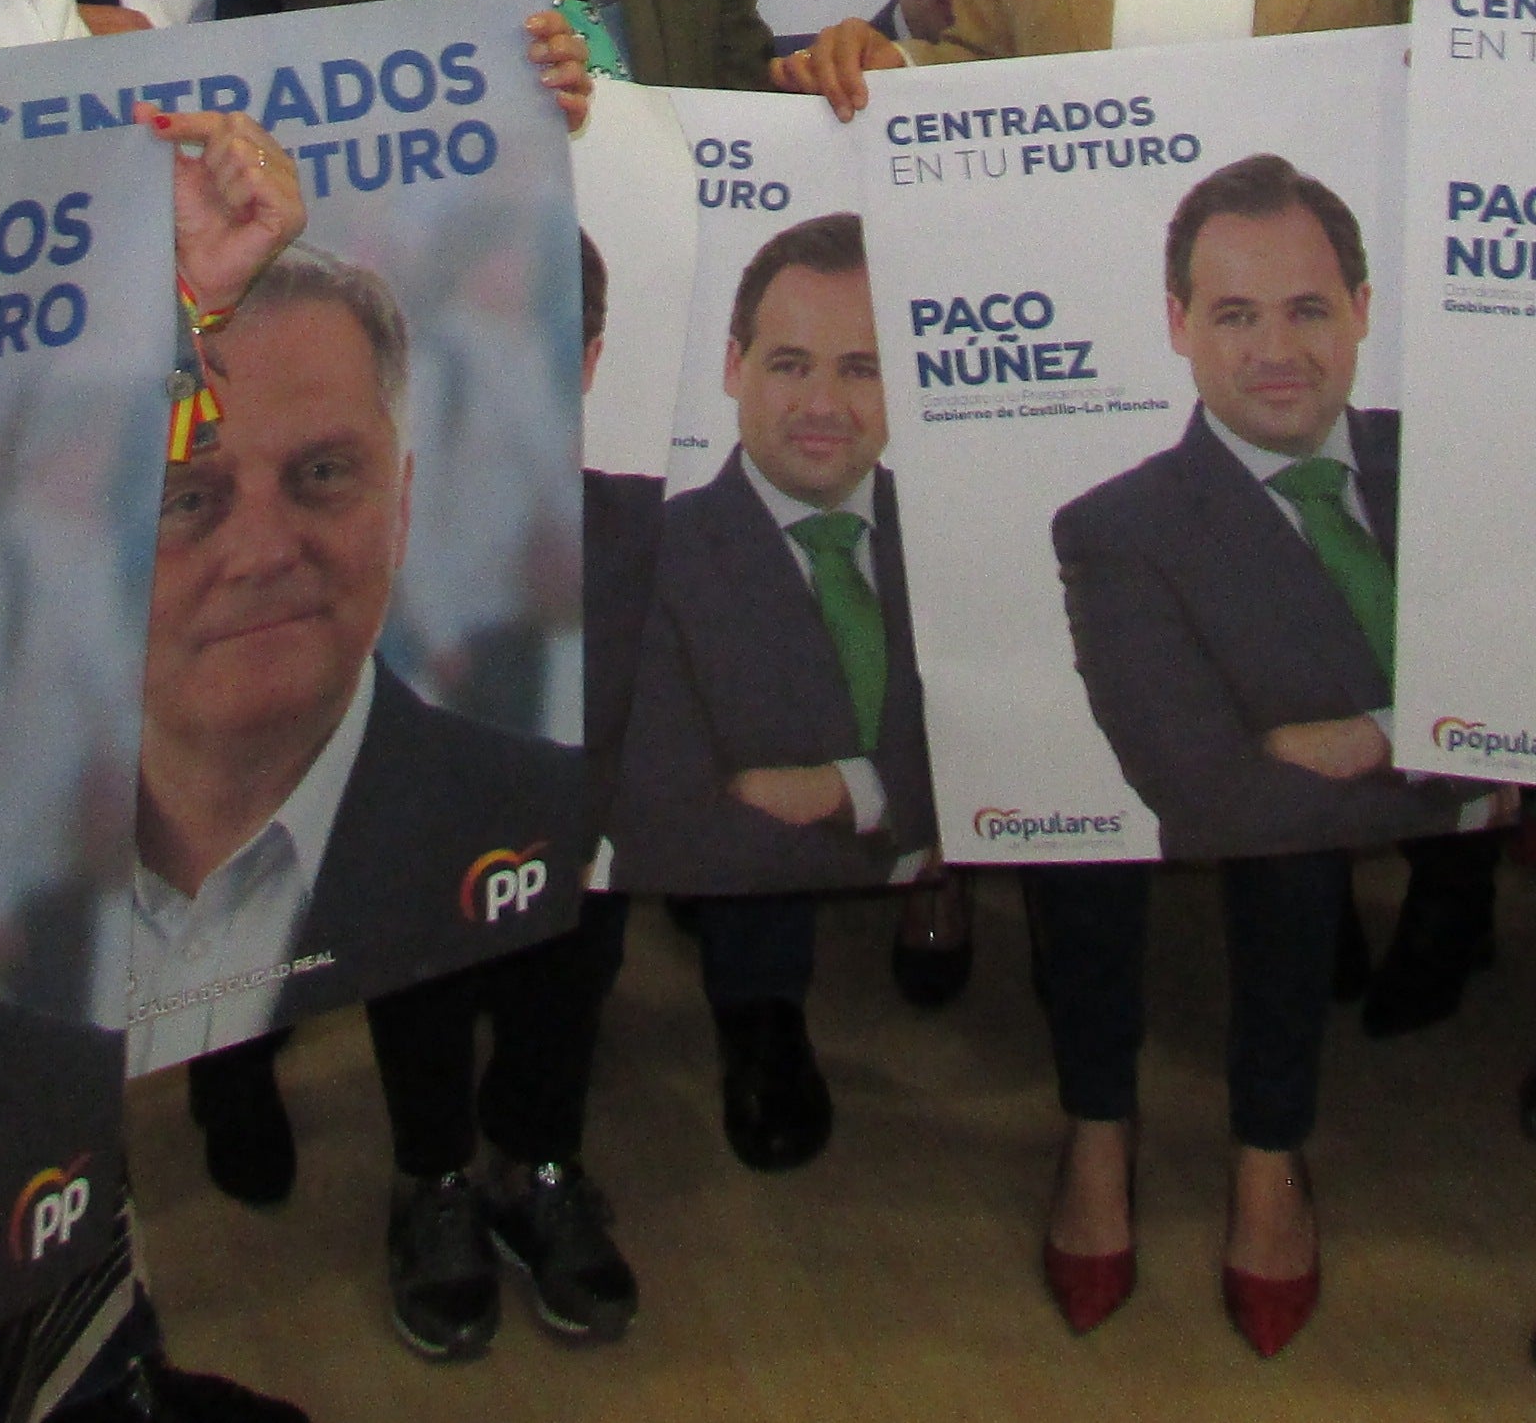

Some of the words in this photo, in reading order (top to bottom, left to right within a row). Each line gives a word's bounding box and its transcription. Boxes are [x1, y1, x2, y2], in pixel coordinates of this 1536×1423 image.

[1451, 28, 1505, 61] EN
[888, 97, 1155, 145] CENTRADOS
[285, 120, 498, 199] TURO
[891, 152, 942, 186] EN
[955, 146, 1007, 180] TU
[1022, 133, 1201, 176] FUTURO
[699, 180, 790, 211] URO
[911, 291, 1054, 337] PACO
[1443, 298, 1521, 316] Gobierno
[917, 334, 1097, 388] NÚÑEZ
[923, 408, 993, 423] Gobierno
[997, 406, 1013, 419] de
[1018, 401, 1104, 417] Castilla-La
[1107, 398, 1170, 413] Mancha
[989, 810, 1122, 840] populares
